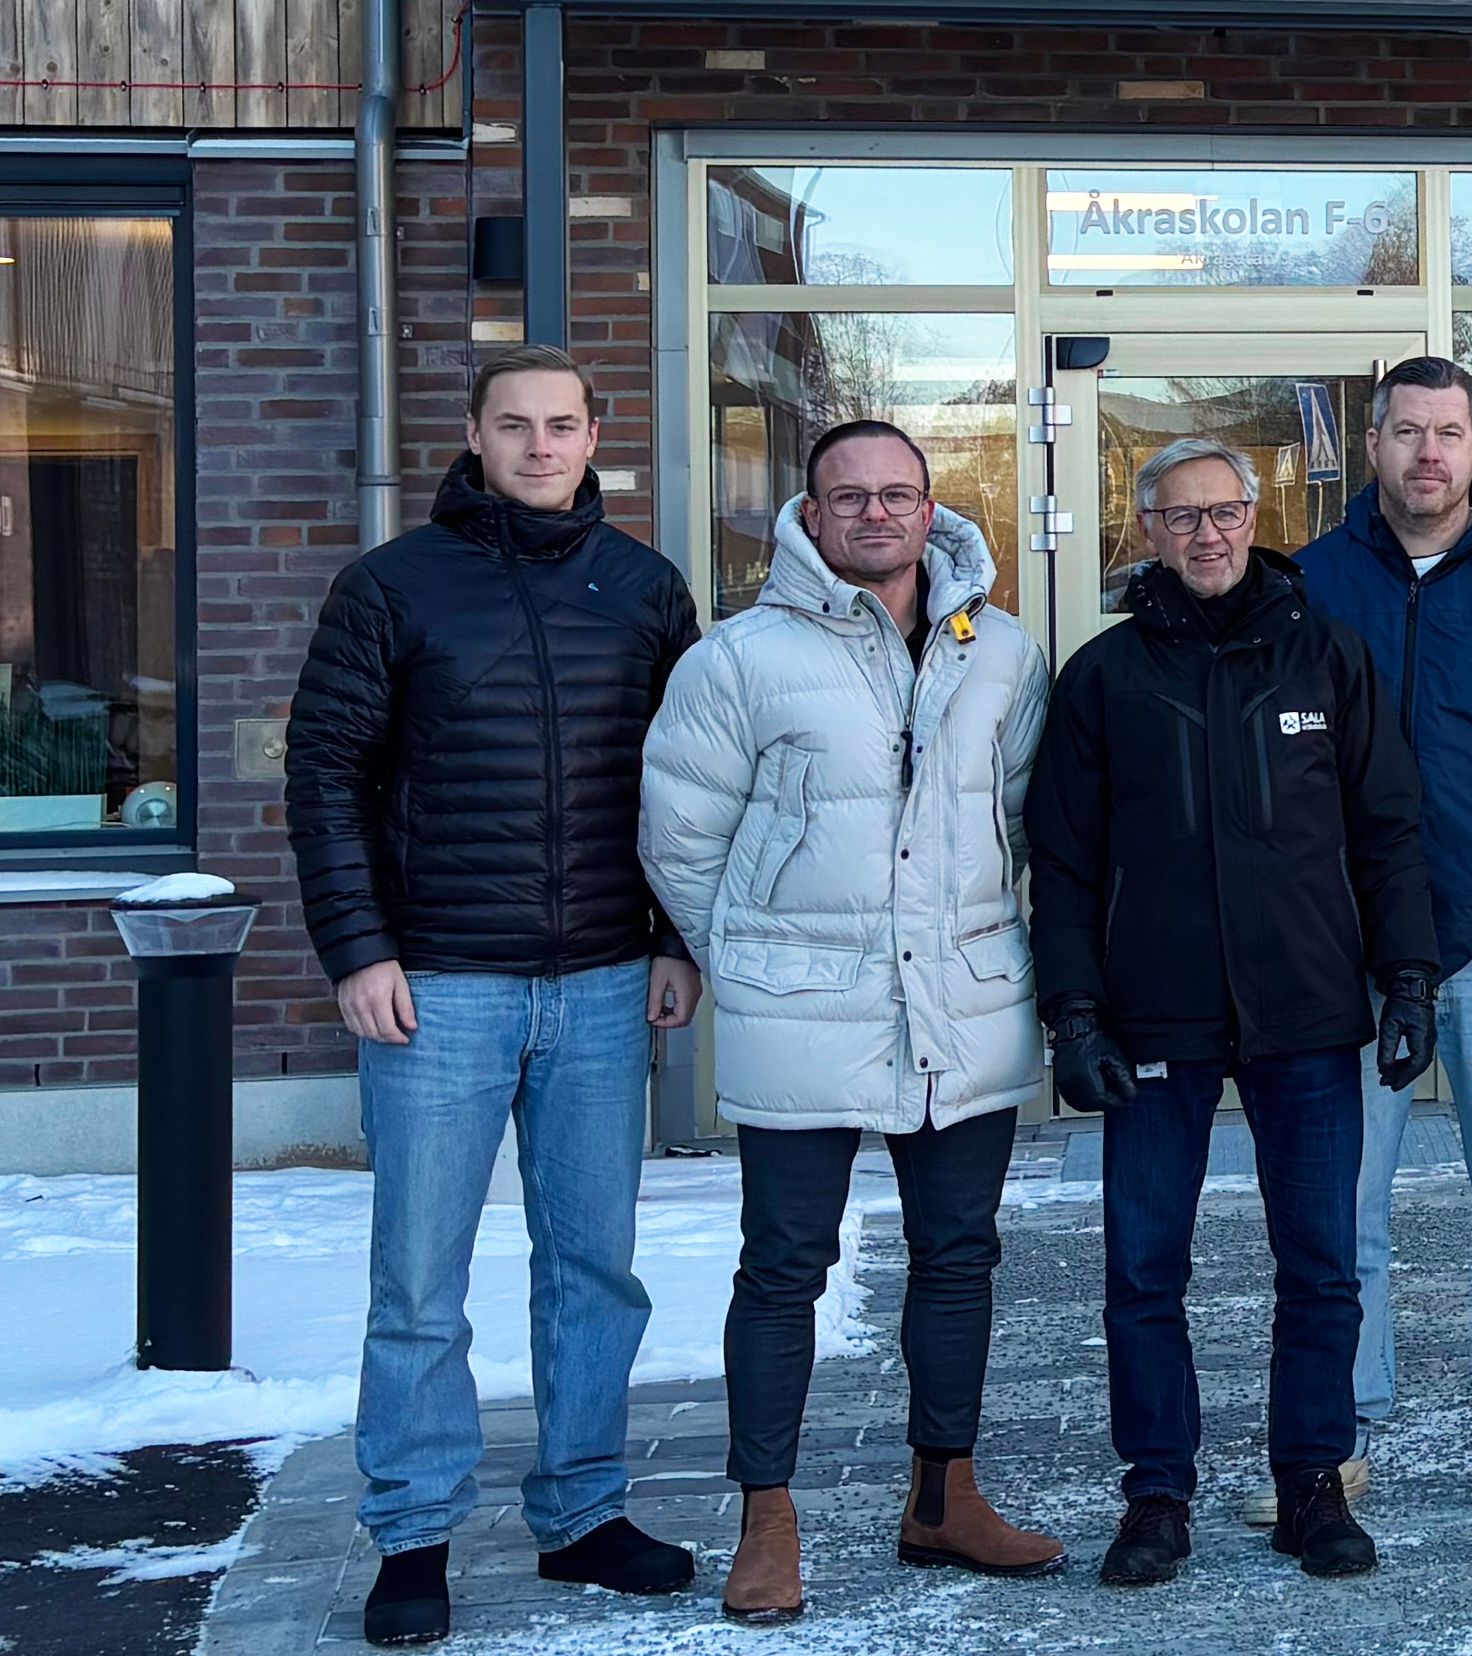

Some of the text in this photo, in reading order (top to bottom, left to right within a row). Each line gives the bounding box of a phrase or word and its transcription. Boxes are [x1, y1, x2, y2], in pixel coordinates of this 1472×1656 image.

[1079, 188, 1390, 235] Åkraskolan F-6
[1300, 711, 1326, 724] SALA
